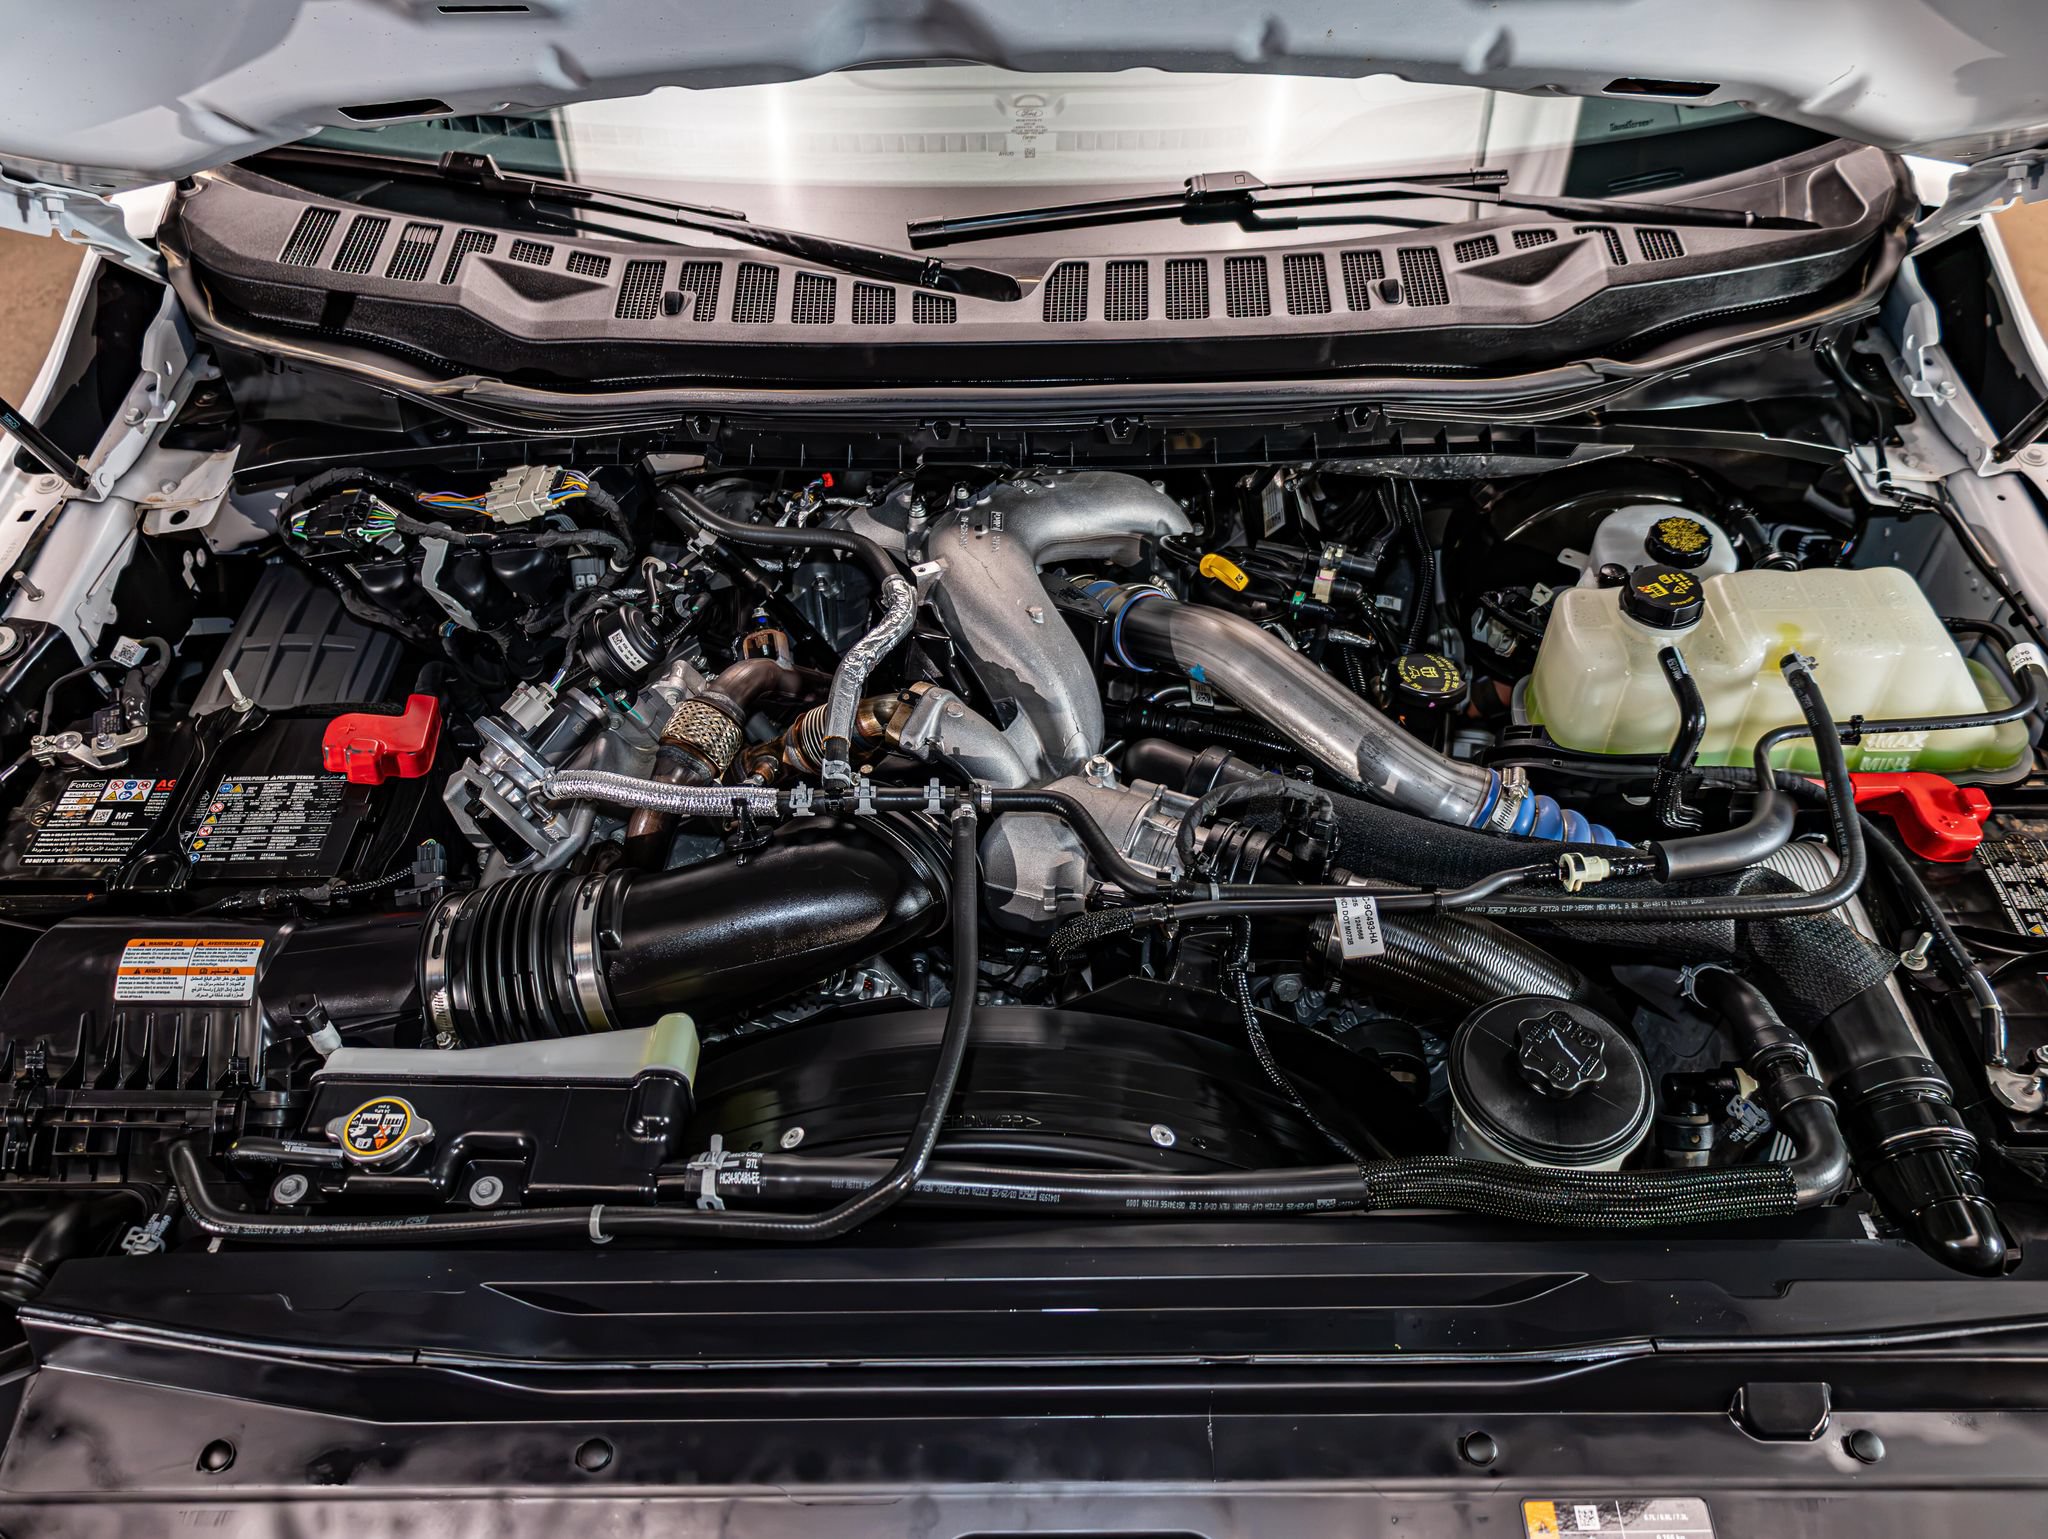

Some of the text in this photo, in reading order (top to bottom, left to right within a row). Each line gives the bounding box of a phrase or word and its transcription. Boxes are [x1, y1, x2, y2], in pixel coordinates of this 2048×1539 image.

[1859, 756, 1903, 770] MIN
[114, 812, 134, 820] MF
[1342, 910, 1350, 925] DOT
[745, 1158, 759, 1169] BTL
